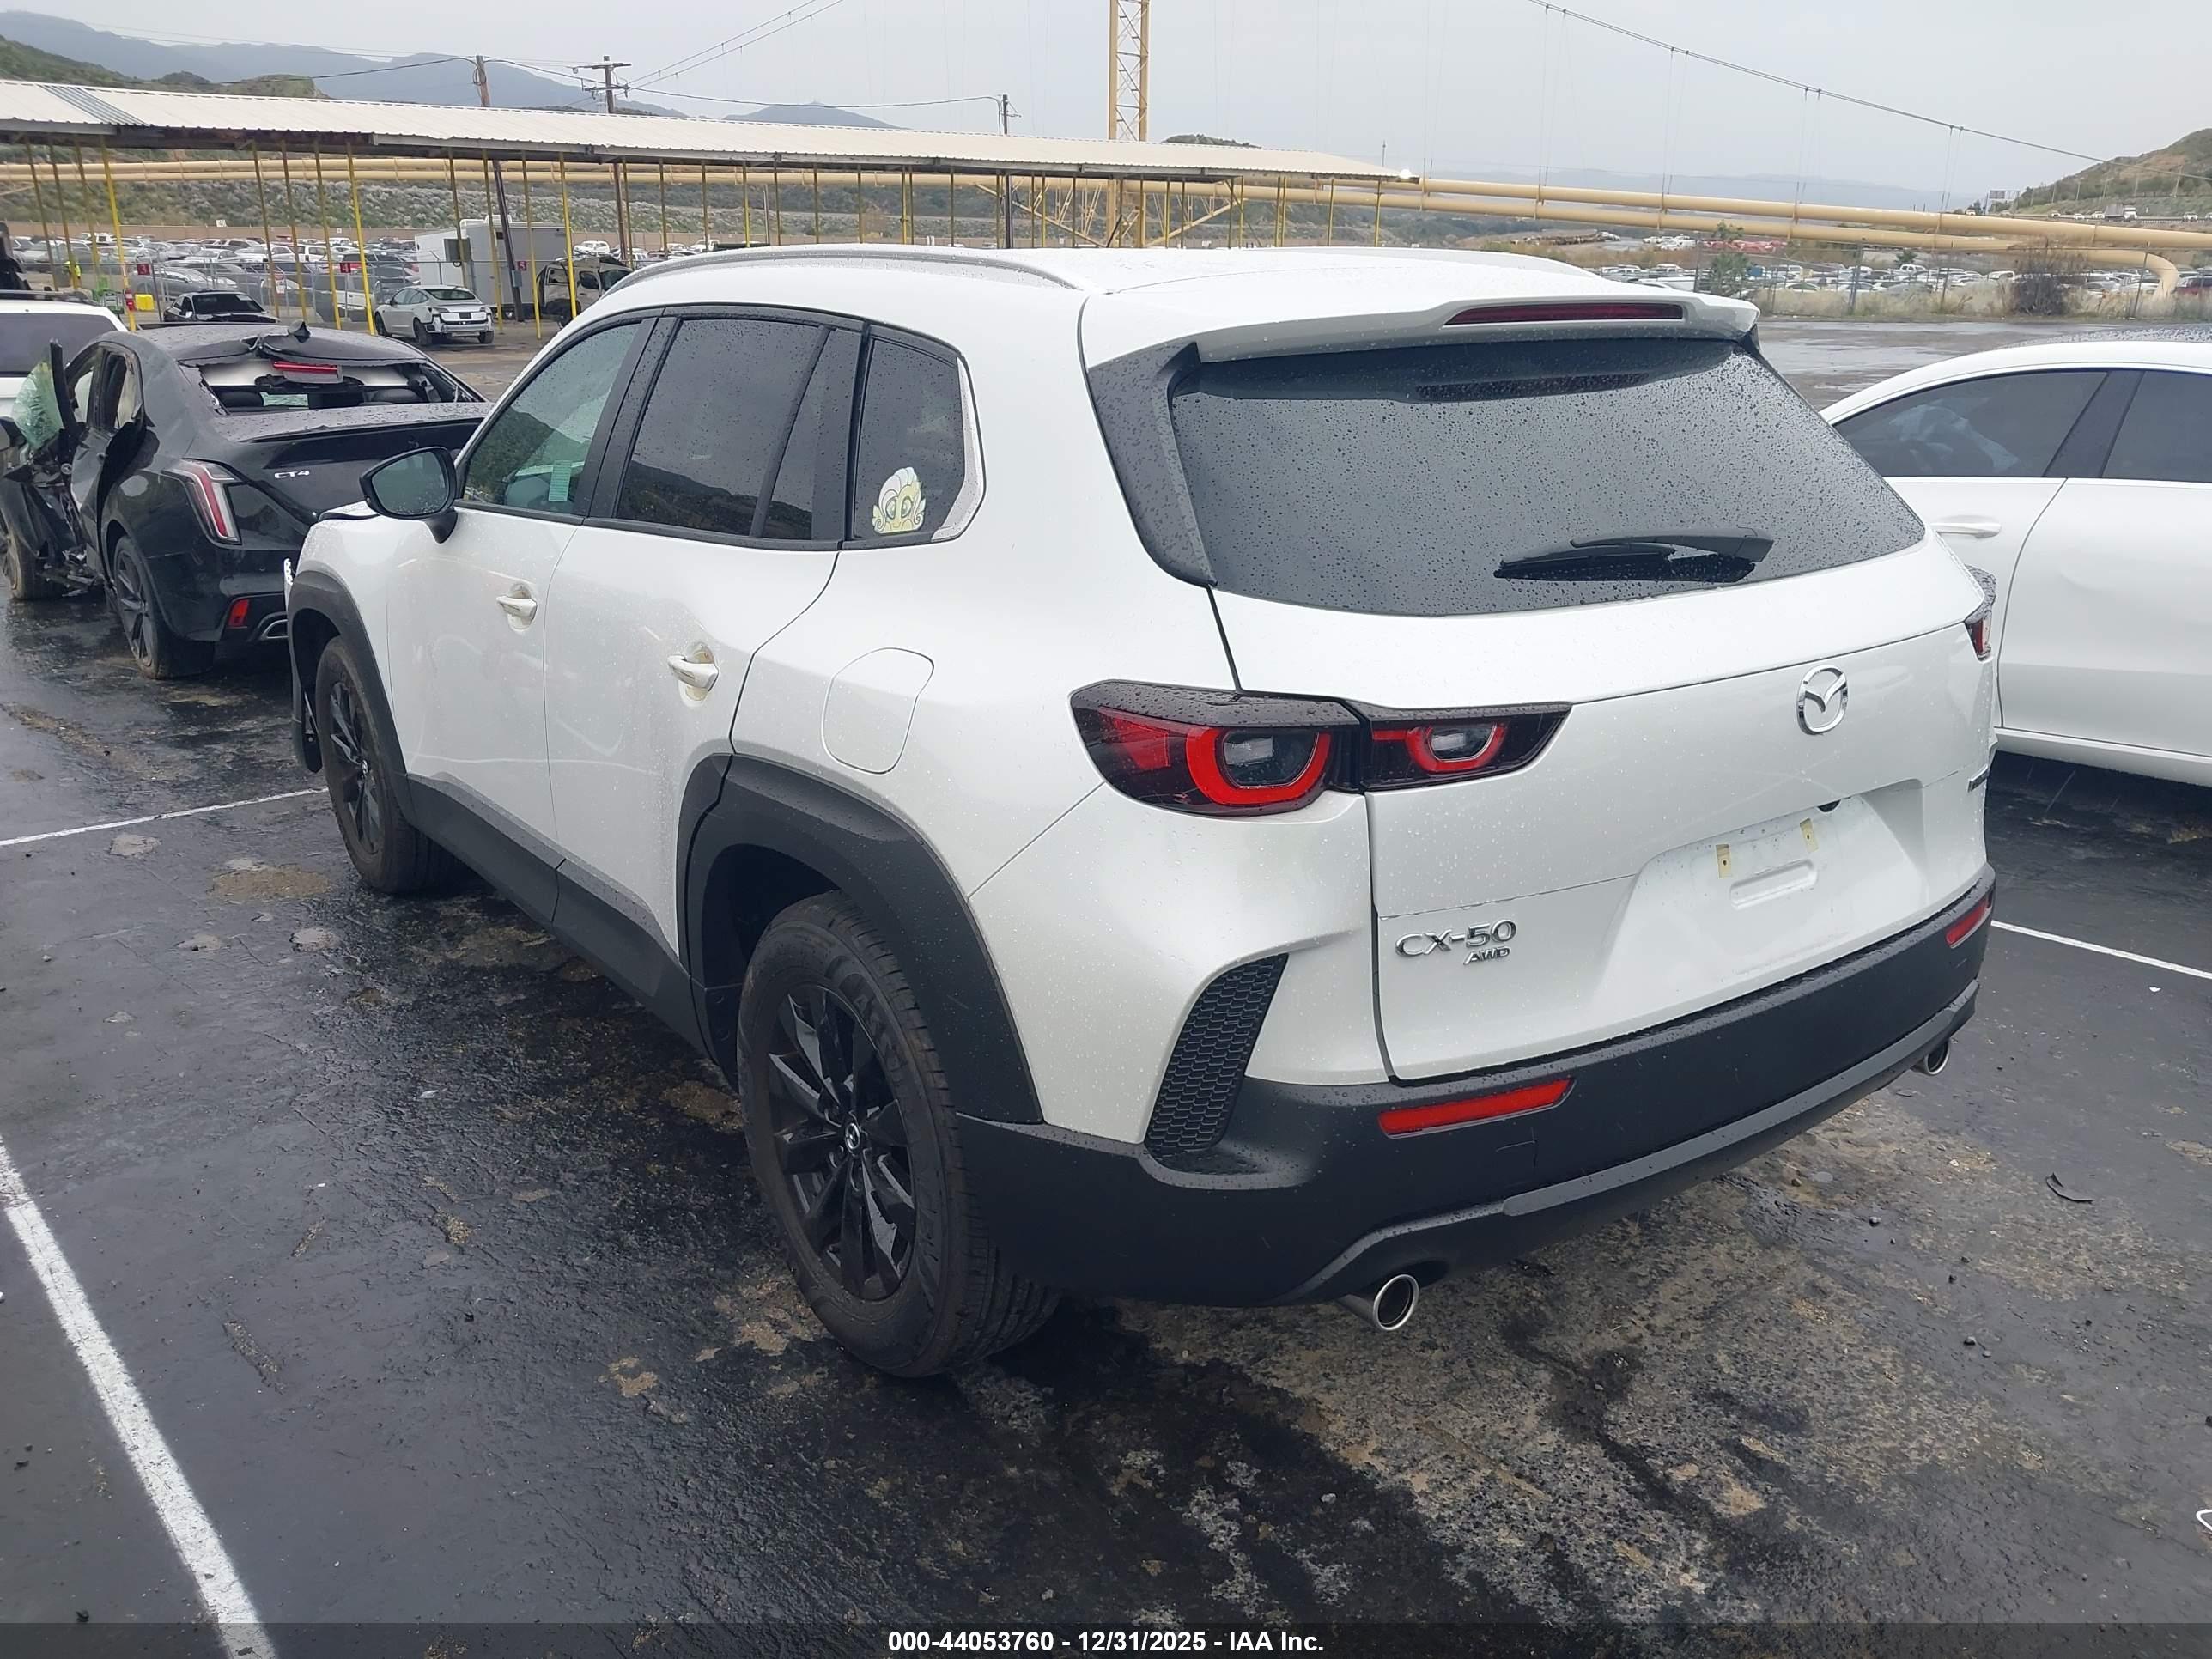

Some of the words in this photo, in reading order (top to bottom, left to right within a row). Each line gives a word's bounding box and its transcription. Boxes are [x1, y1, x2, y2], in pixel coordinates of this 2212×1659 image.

[274, 470, 310, 479] CT4
[1395, 919, 1517, 957] CX-50
[1462, 945, 1511, 966] AWD
